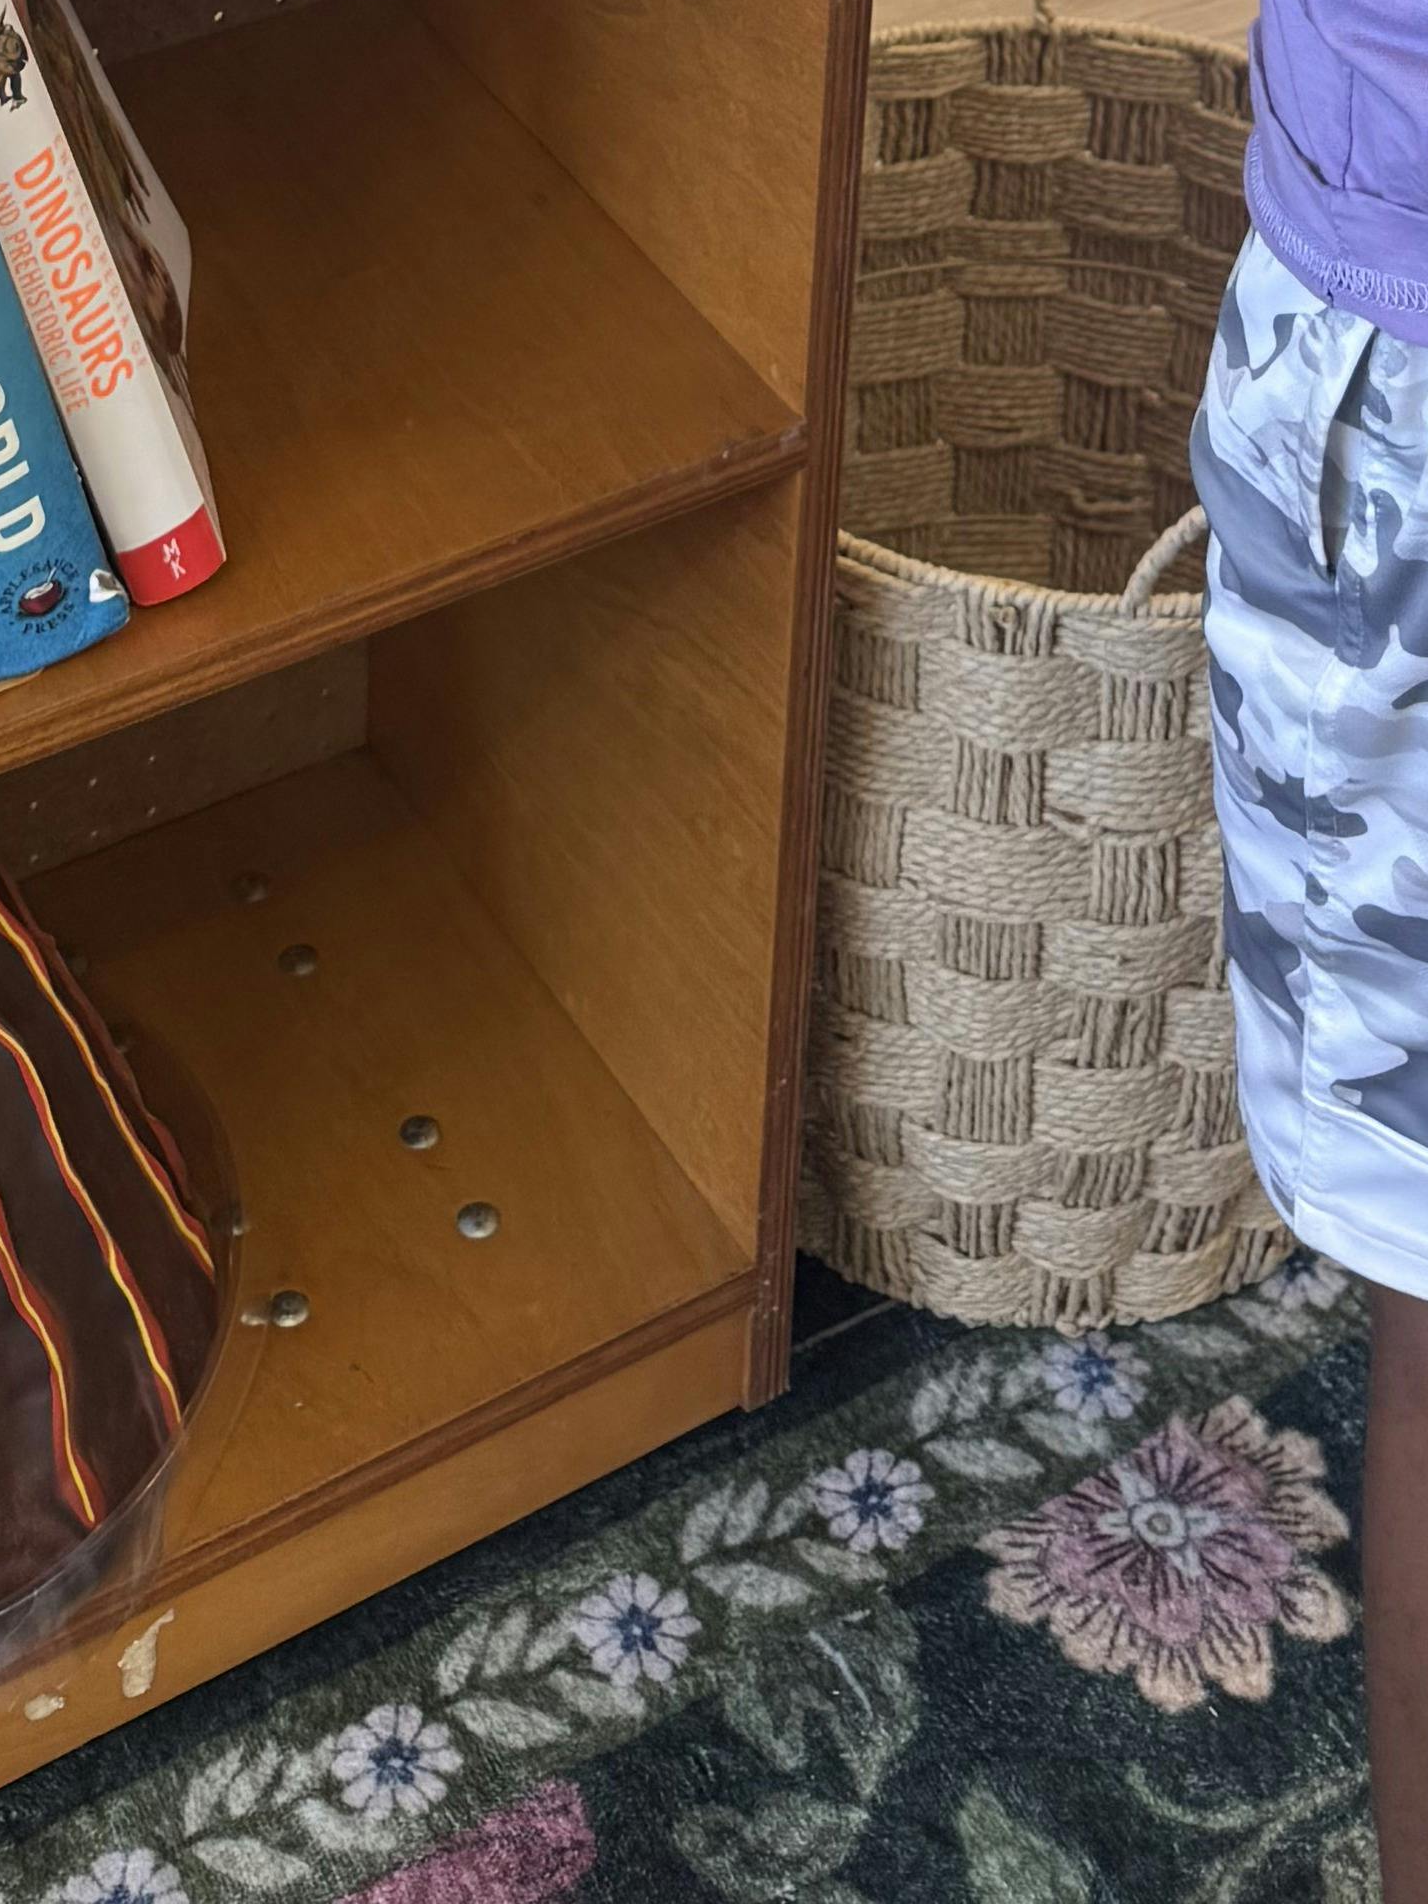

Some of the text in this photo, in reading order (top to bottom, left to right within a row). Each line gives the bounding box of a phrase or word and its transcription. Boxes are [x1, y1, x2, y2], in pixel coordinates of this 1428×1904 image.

[7, 229, 73, 366] PREHISTORIC
[52, 367, 90, 414] LIFE
[14, 146, 134, 399] DINOSAURS
[0, 557, 81, 616] APPLESAUCE
[22, 602, 75, 634] PRESS
